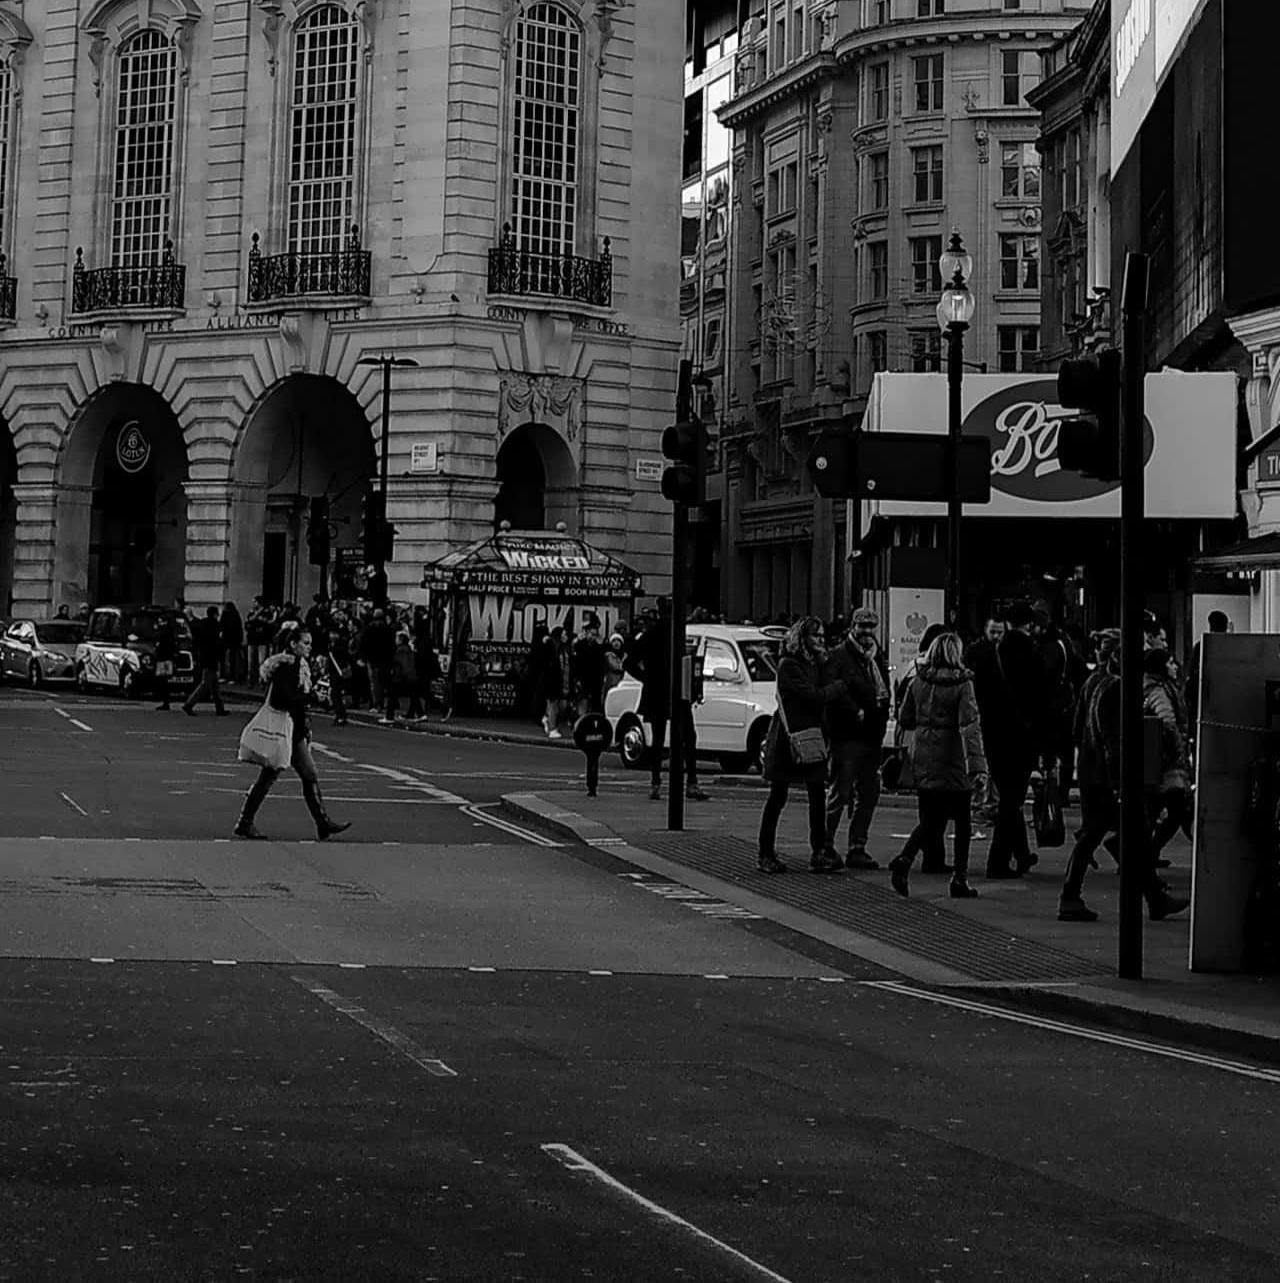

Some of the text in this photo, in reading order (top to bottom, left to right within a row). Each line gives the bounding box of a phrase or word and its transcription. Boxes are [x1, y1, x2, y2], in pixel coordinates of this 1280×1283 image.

[597, 320, 630, 335] OFFICE
[501, 572, 529, 584] BEST
[530, 572, 568, 586] SHOW
[569, 574, 581, 586] IN
